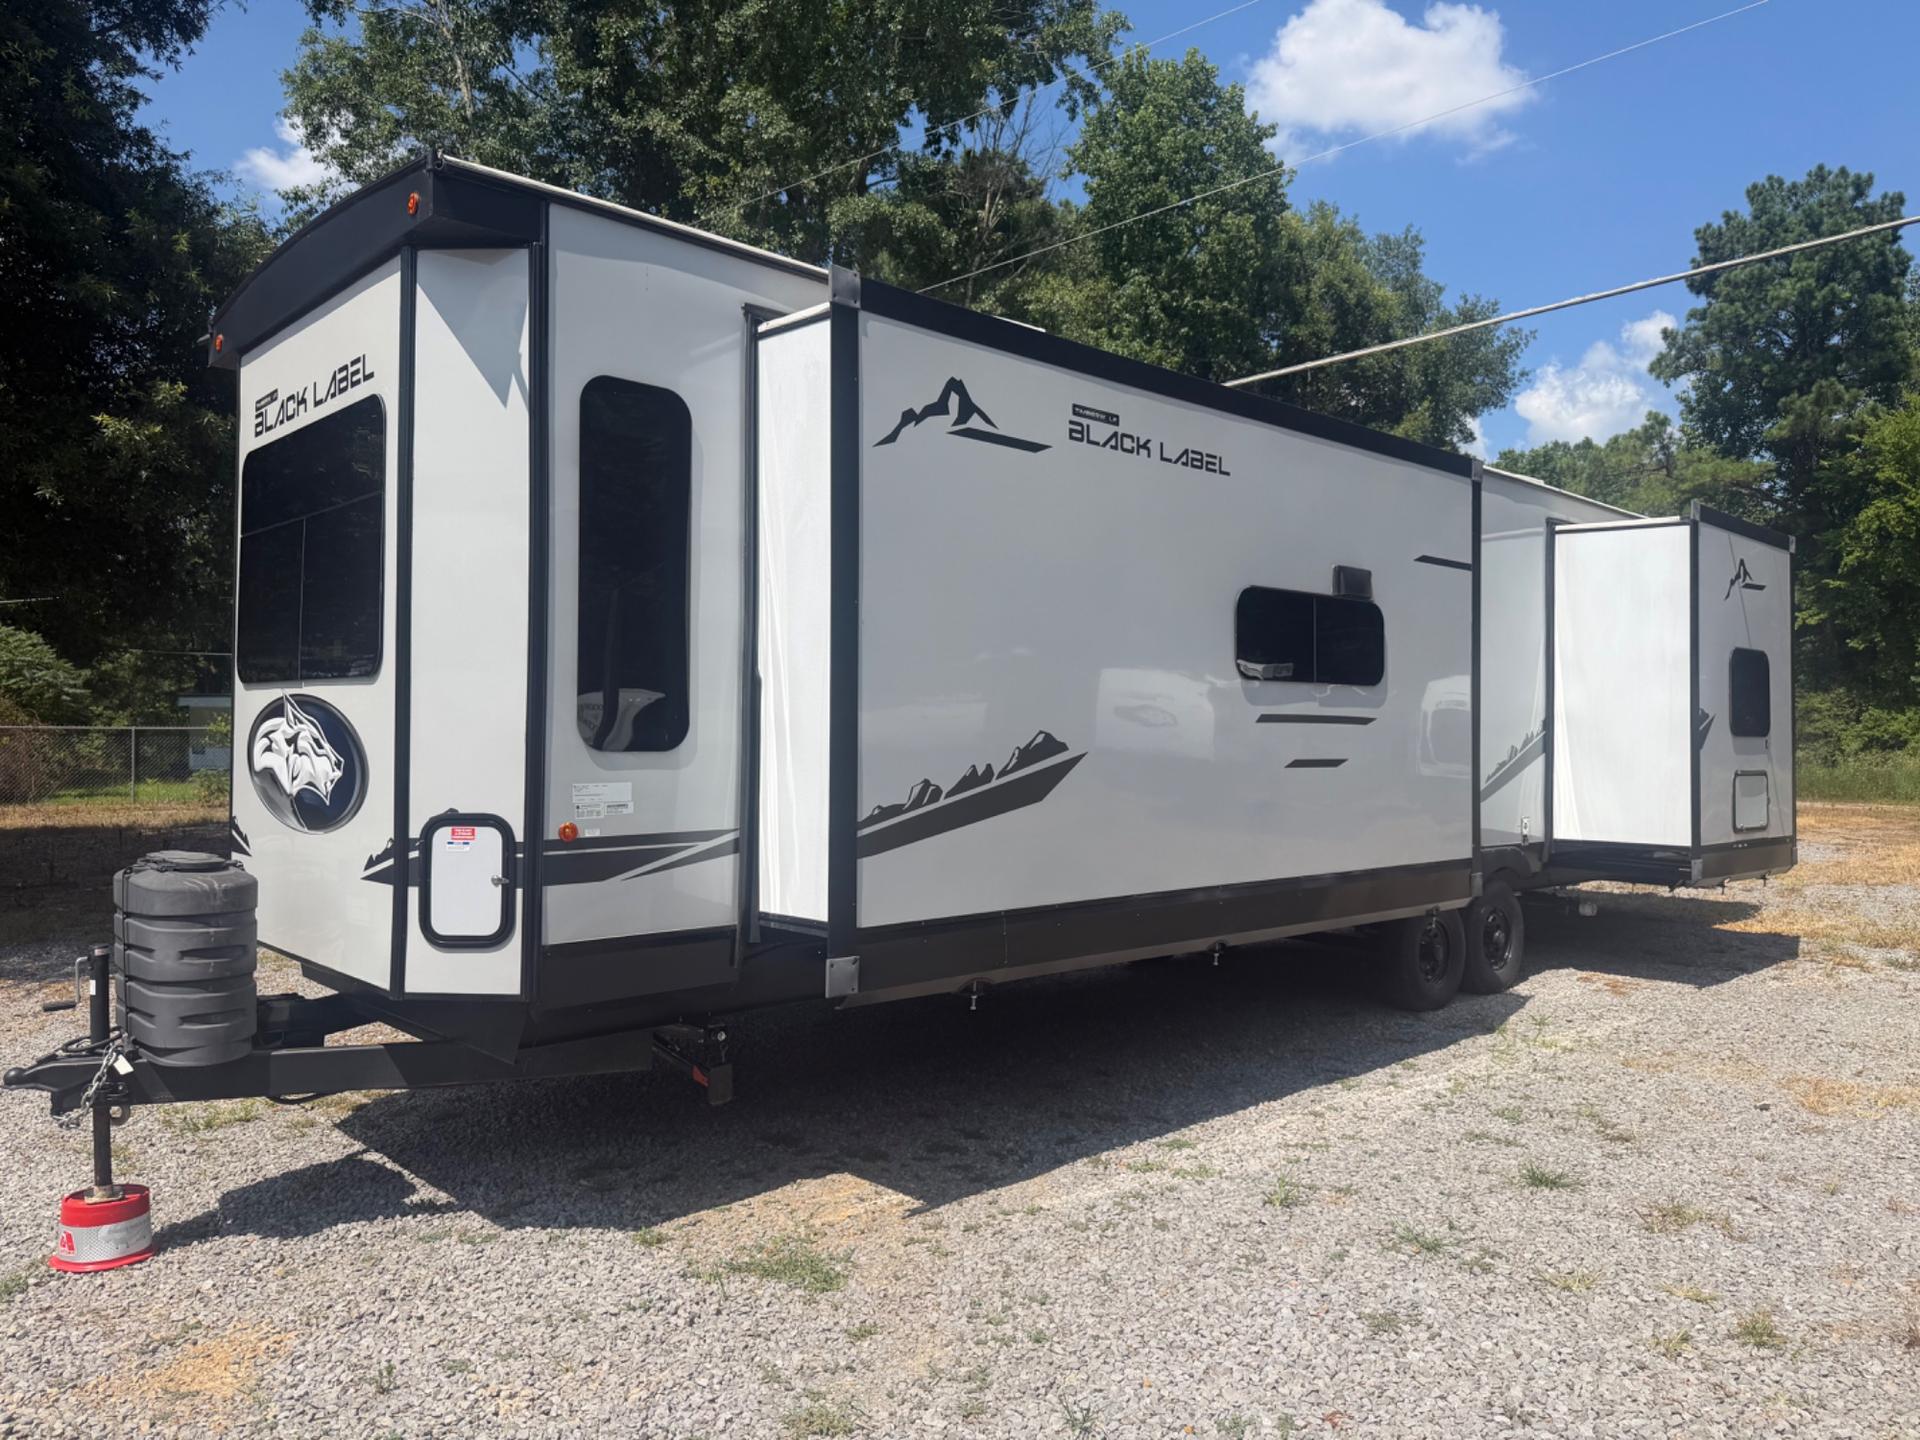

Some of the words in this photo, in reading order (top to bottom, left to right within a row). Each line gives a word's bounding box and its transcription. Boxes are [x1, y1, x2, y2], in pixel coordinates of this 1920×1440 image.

[254, 386, 308, 438] BLACK
[313, 353, 375, 408] LABEL
[1068, 420, 1152, 458] BLACK
[1159, 442, 1231, 476] LABEL
